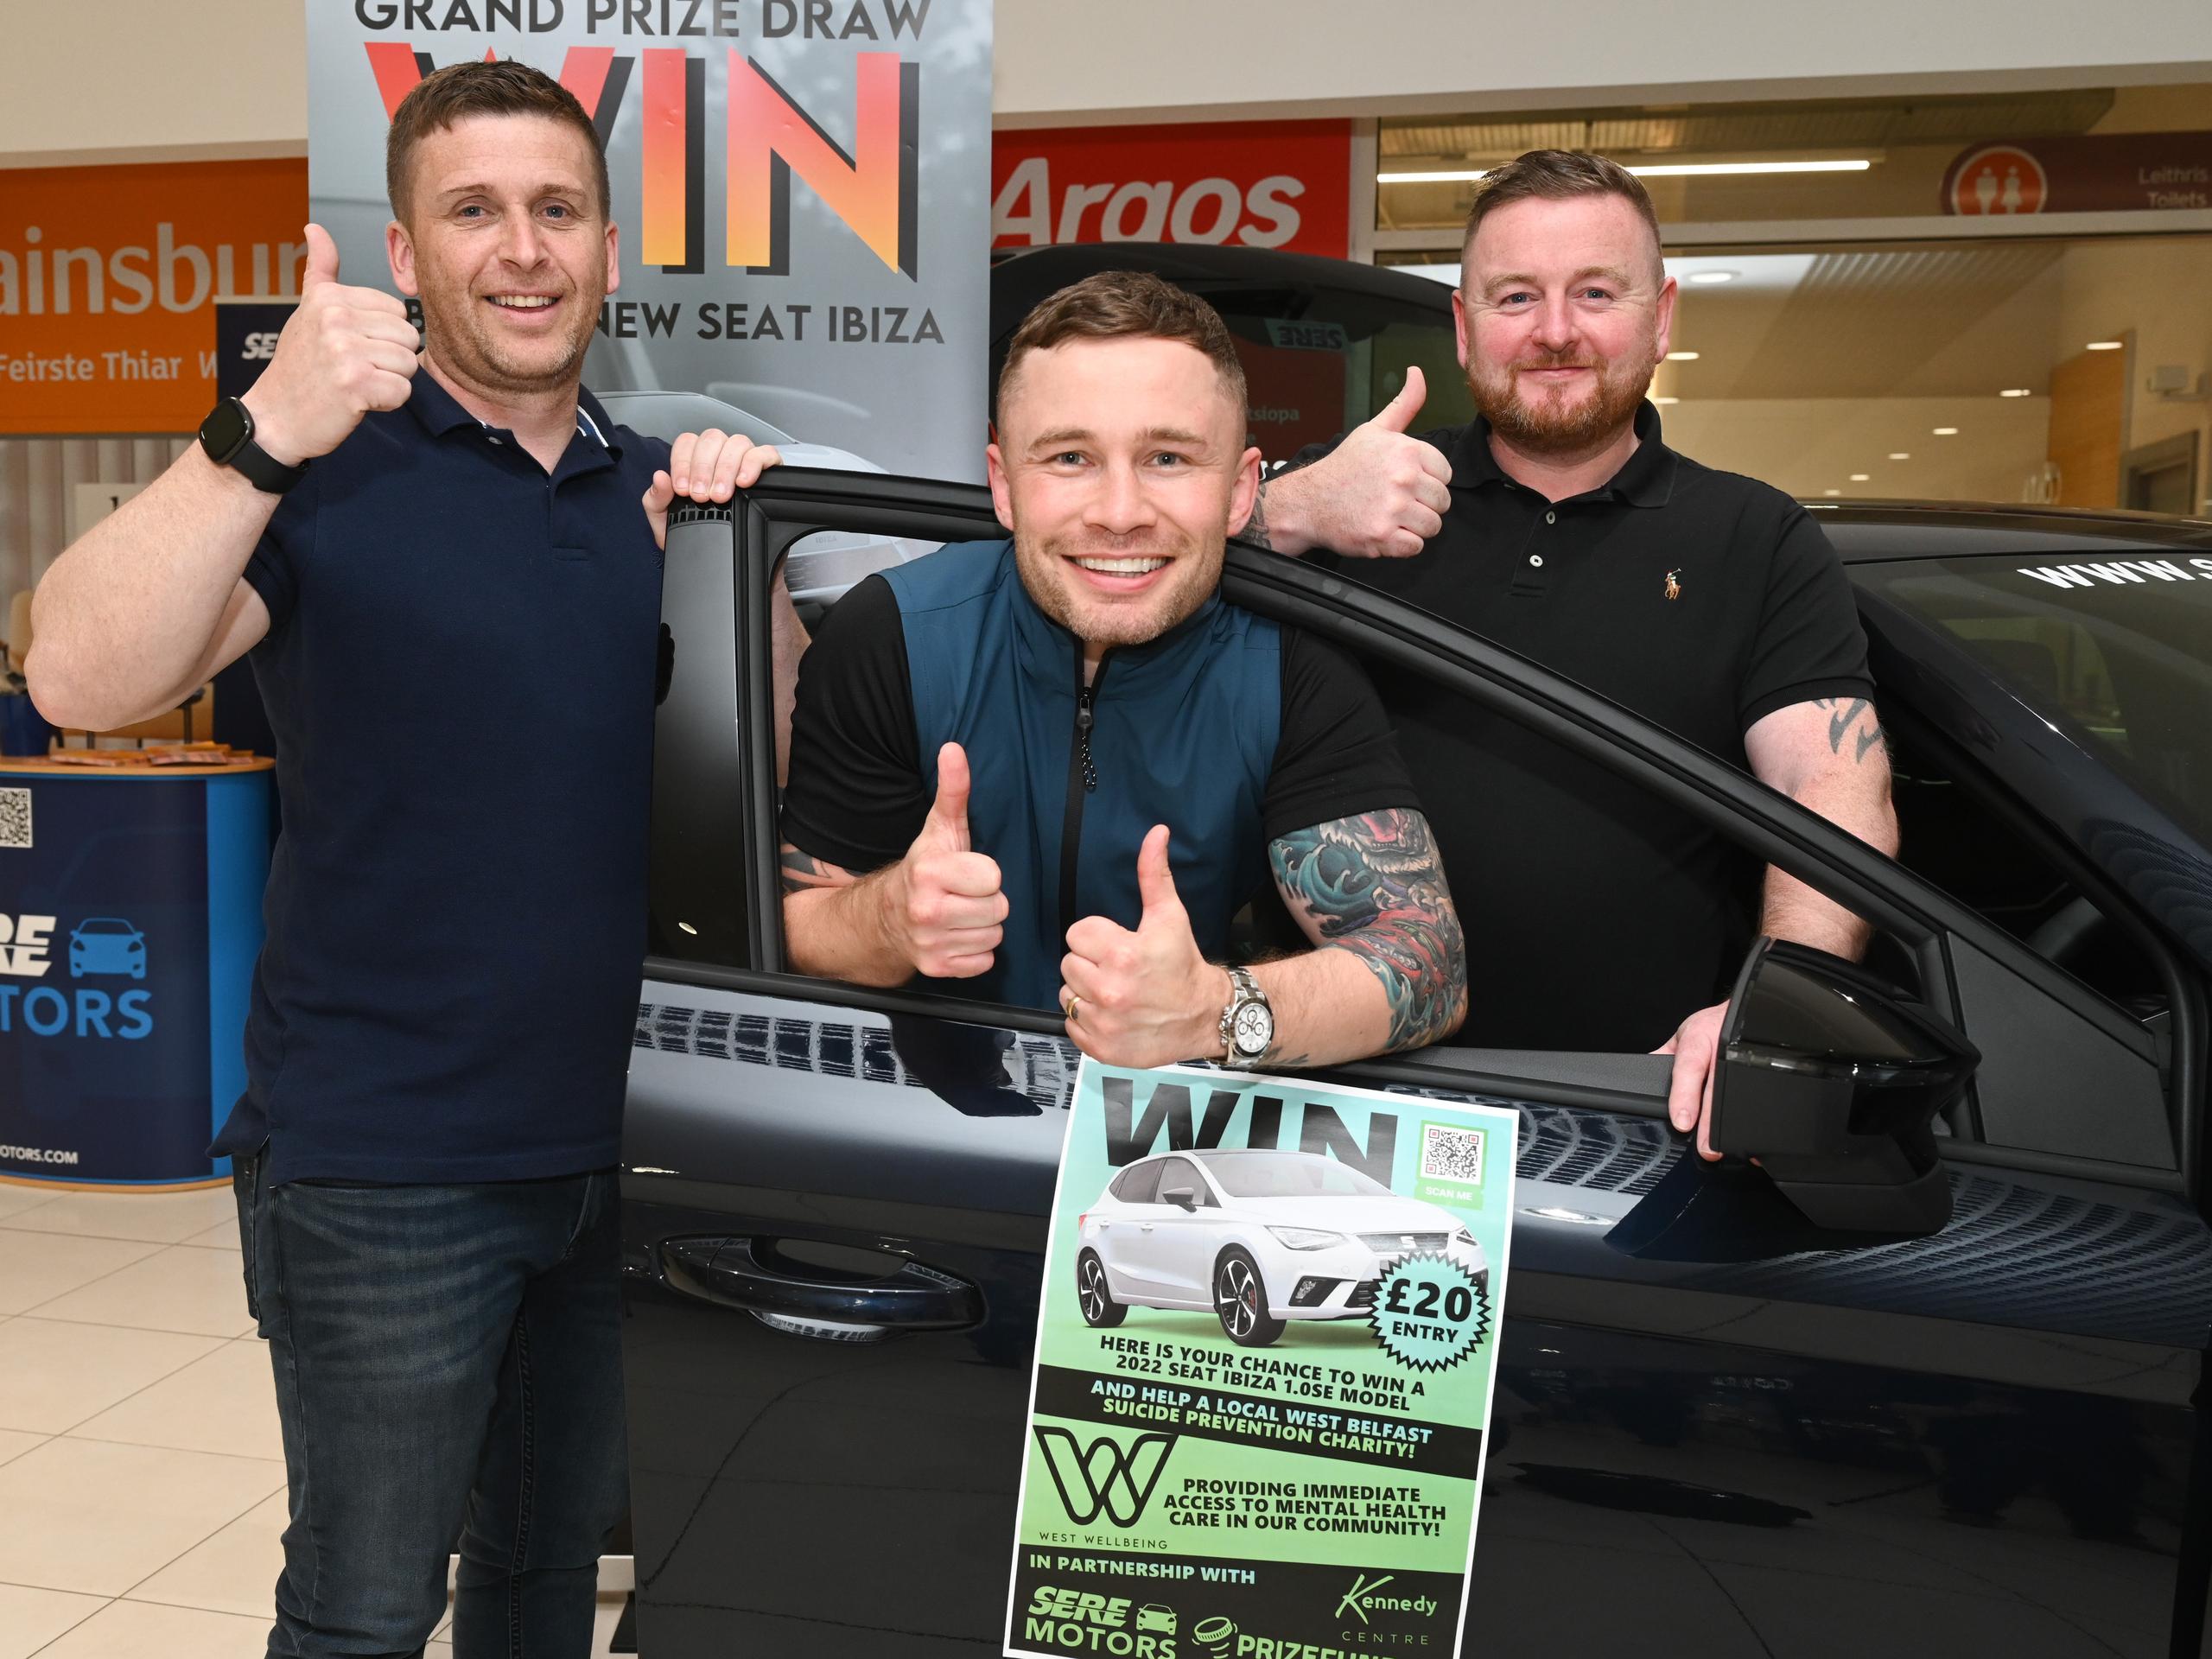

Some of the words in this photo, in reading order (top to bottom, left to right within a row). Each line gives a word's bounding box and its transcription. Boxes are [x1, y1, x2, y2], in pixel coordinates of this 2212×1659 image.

[356, 0, 564, 34] GRAND
[588, 0, 739, 37] PRIZE
[762, 0, 931, 41] DRAW
[696, 302, 811, 340] SEAT
[829, 305, 945, 344] IBIZA
[102, 351, 181, 381] Thiar
[1102, 1077, 1398, 1196] WIN
[1425, 1185, 1454, 1198] SCAN
[1456, 1192, 1473, 1201] ME
[1384, 1278, 1472, 1322] £20
[1392, 1320, 1459, 1343] ENTRY
[1100, 1335, 1150, 1356] HERE
[1156, 1344, 1173, 1359] IS
[1179, 1346, 1234, 1368] YOUR
[1240, 1356, 1322, 1381] CHANCE
[1329, 1368, 1356, 1385] TO
[1362, 1373, 1405, 1393] WIN
[1410, 1381, 1425, 1396] A
[1116, 1354, 1162, 1374] 2022
[1168, 1363, 1217, 1382] SEAT
[1223, 1370, 1277, 1391] IBIZA
[1284, 1379, 1333, 1400] 1.0SE
[1340, 1388, 1410, 1411] MODEL
[1090, 1380, 1136, 1399] AND
[1141, 1387, 1192, 1407] HELP
[1196, 1395, 1211, 1411] A
[1217, 1398, 1279, 1421] LOCAL
[1286, 1408, 1342, 1430] WEST
[1346, 1418, 1433, 1444] BELFAST
[1103, 1398, 1180, 1423] SUICIDE
[1185, 1409, 1313, 1444] PREVENTION
[1319, 1431, 1415, 1459] CHARITY!
[1163, 1494, 1236, 1511] ACCESS
[1242, 1497, 1269, 1512] TO
[1275, 1499, 1359, 1516] MENTAL
[1366, 1503, 1446, 1520] HEALTH
[1183, 1478, 1297, 1497] PROVIDING
[1303, 1484, 1421, 1502] IMMEDIATE
[1039, 1532, 1077, 1543] WEST
[1084, 1535, 1168, 1549] WELLBEING
[1169, 1511, 1220, 1527] CARE
[1226, 1514, 1248, 1528] IN
[1255, 1515, 1297, 1530] OUR
[1303, 1517, 1440, 1536] COMMUNITY!
[1029, 1554, 1051, 1569] IN
[1057, 1556, 1195, 1580] PARTNERSHIP
[1200, 1567, 1255, 1585] WITH
[1028, 1586, 1132, 1627] SERE
[1335, 1573, 1437, 1624] Kennedy
[1025, 1618, 1177, 1659] MOTORS
[1342, 1631, 1428, 1645] CENTRE
